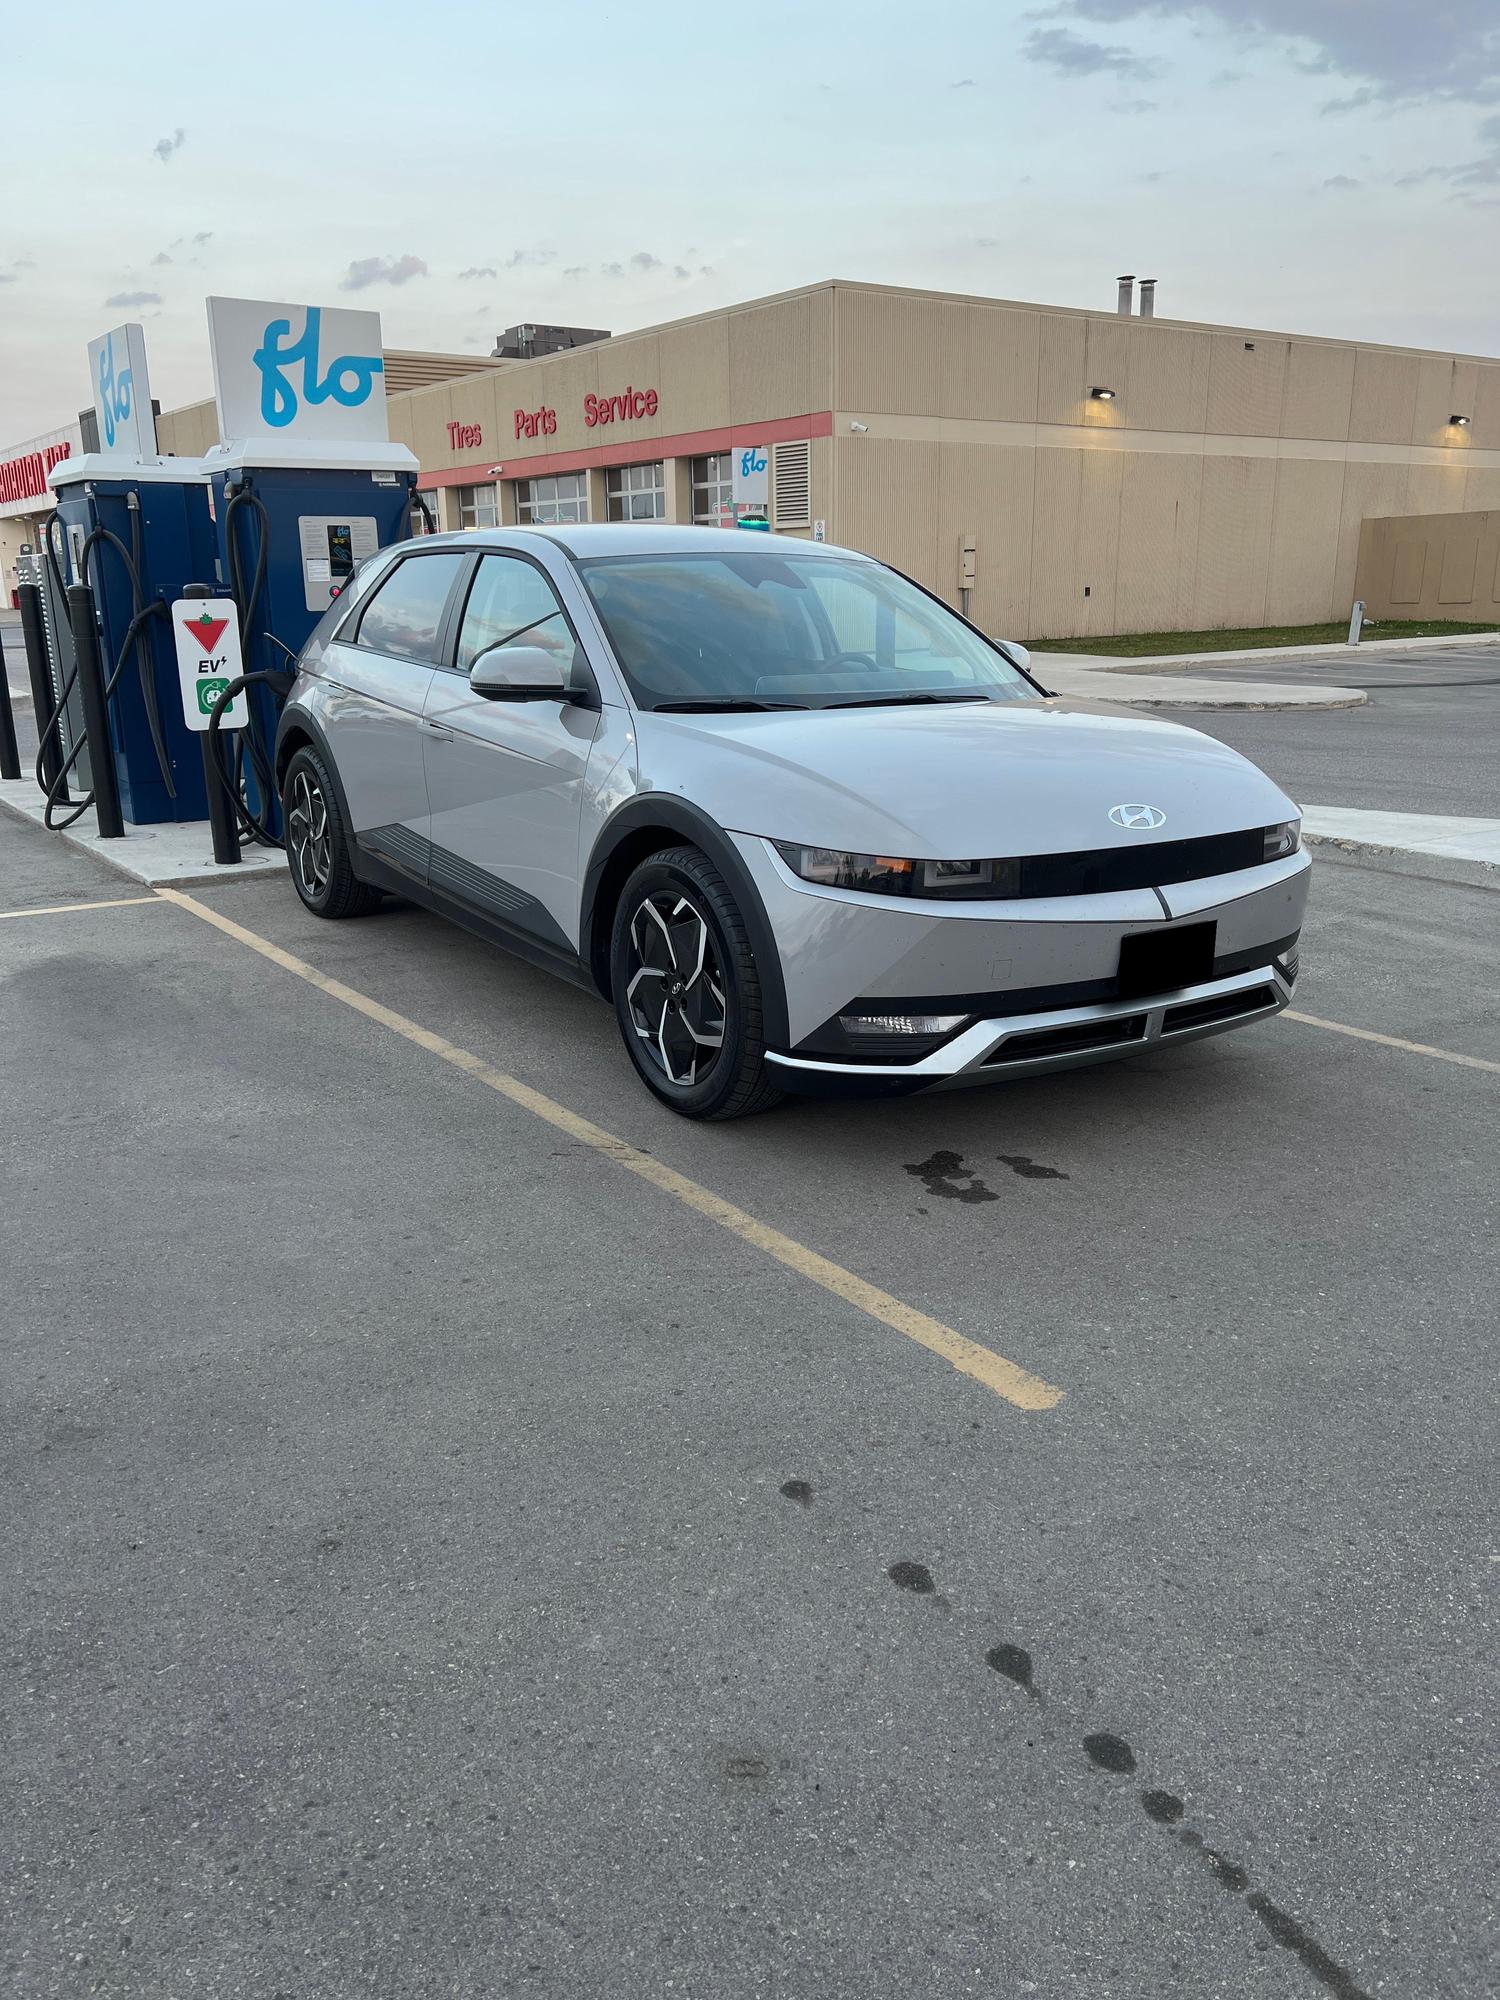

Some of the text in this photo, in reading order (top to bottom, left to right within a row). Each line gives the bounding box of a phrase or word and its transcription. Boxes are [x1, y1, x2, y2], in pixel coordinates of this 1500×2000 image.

[99, 333, 132, 447] flo
[252, 305, 384, 428] flo
[447, 386, 658, 450] Tires Parts Service
[741, 448, 768, 477] flo
[198, 659, 221, 674] EV
